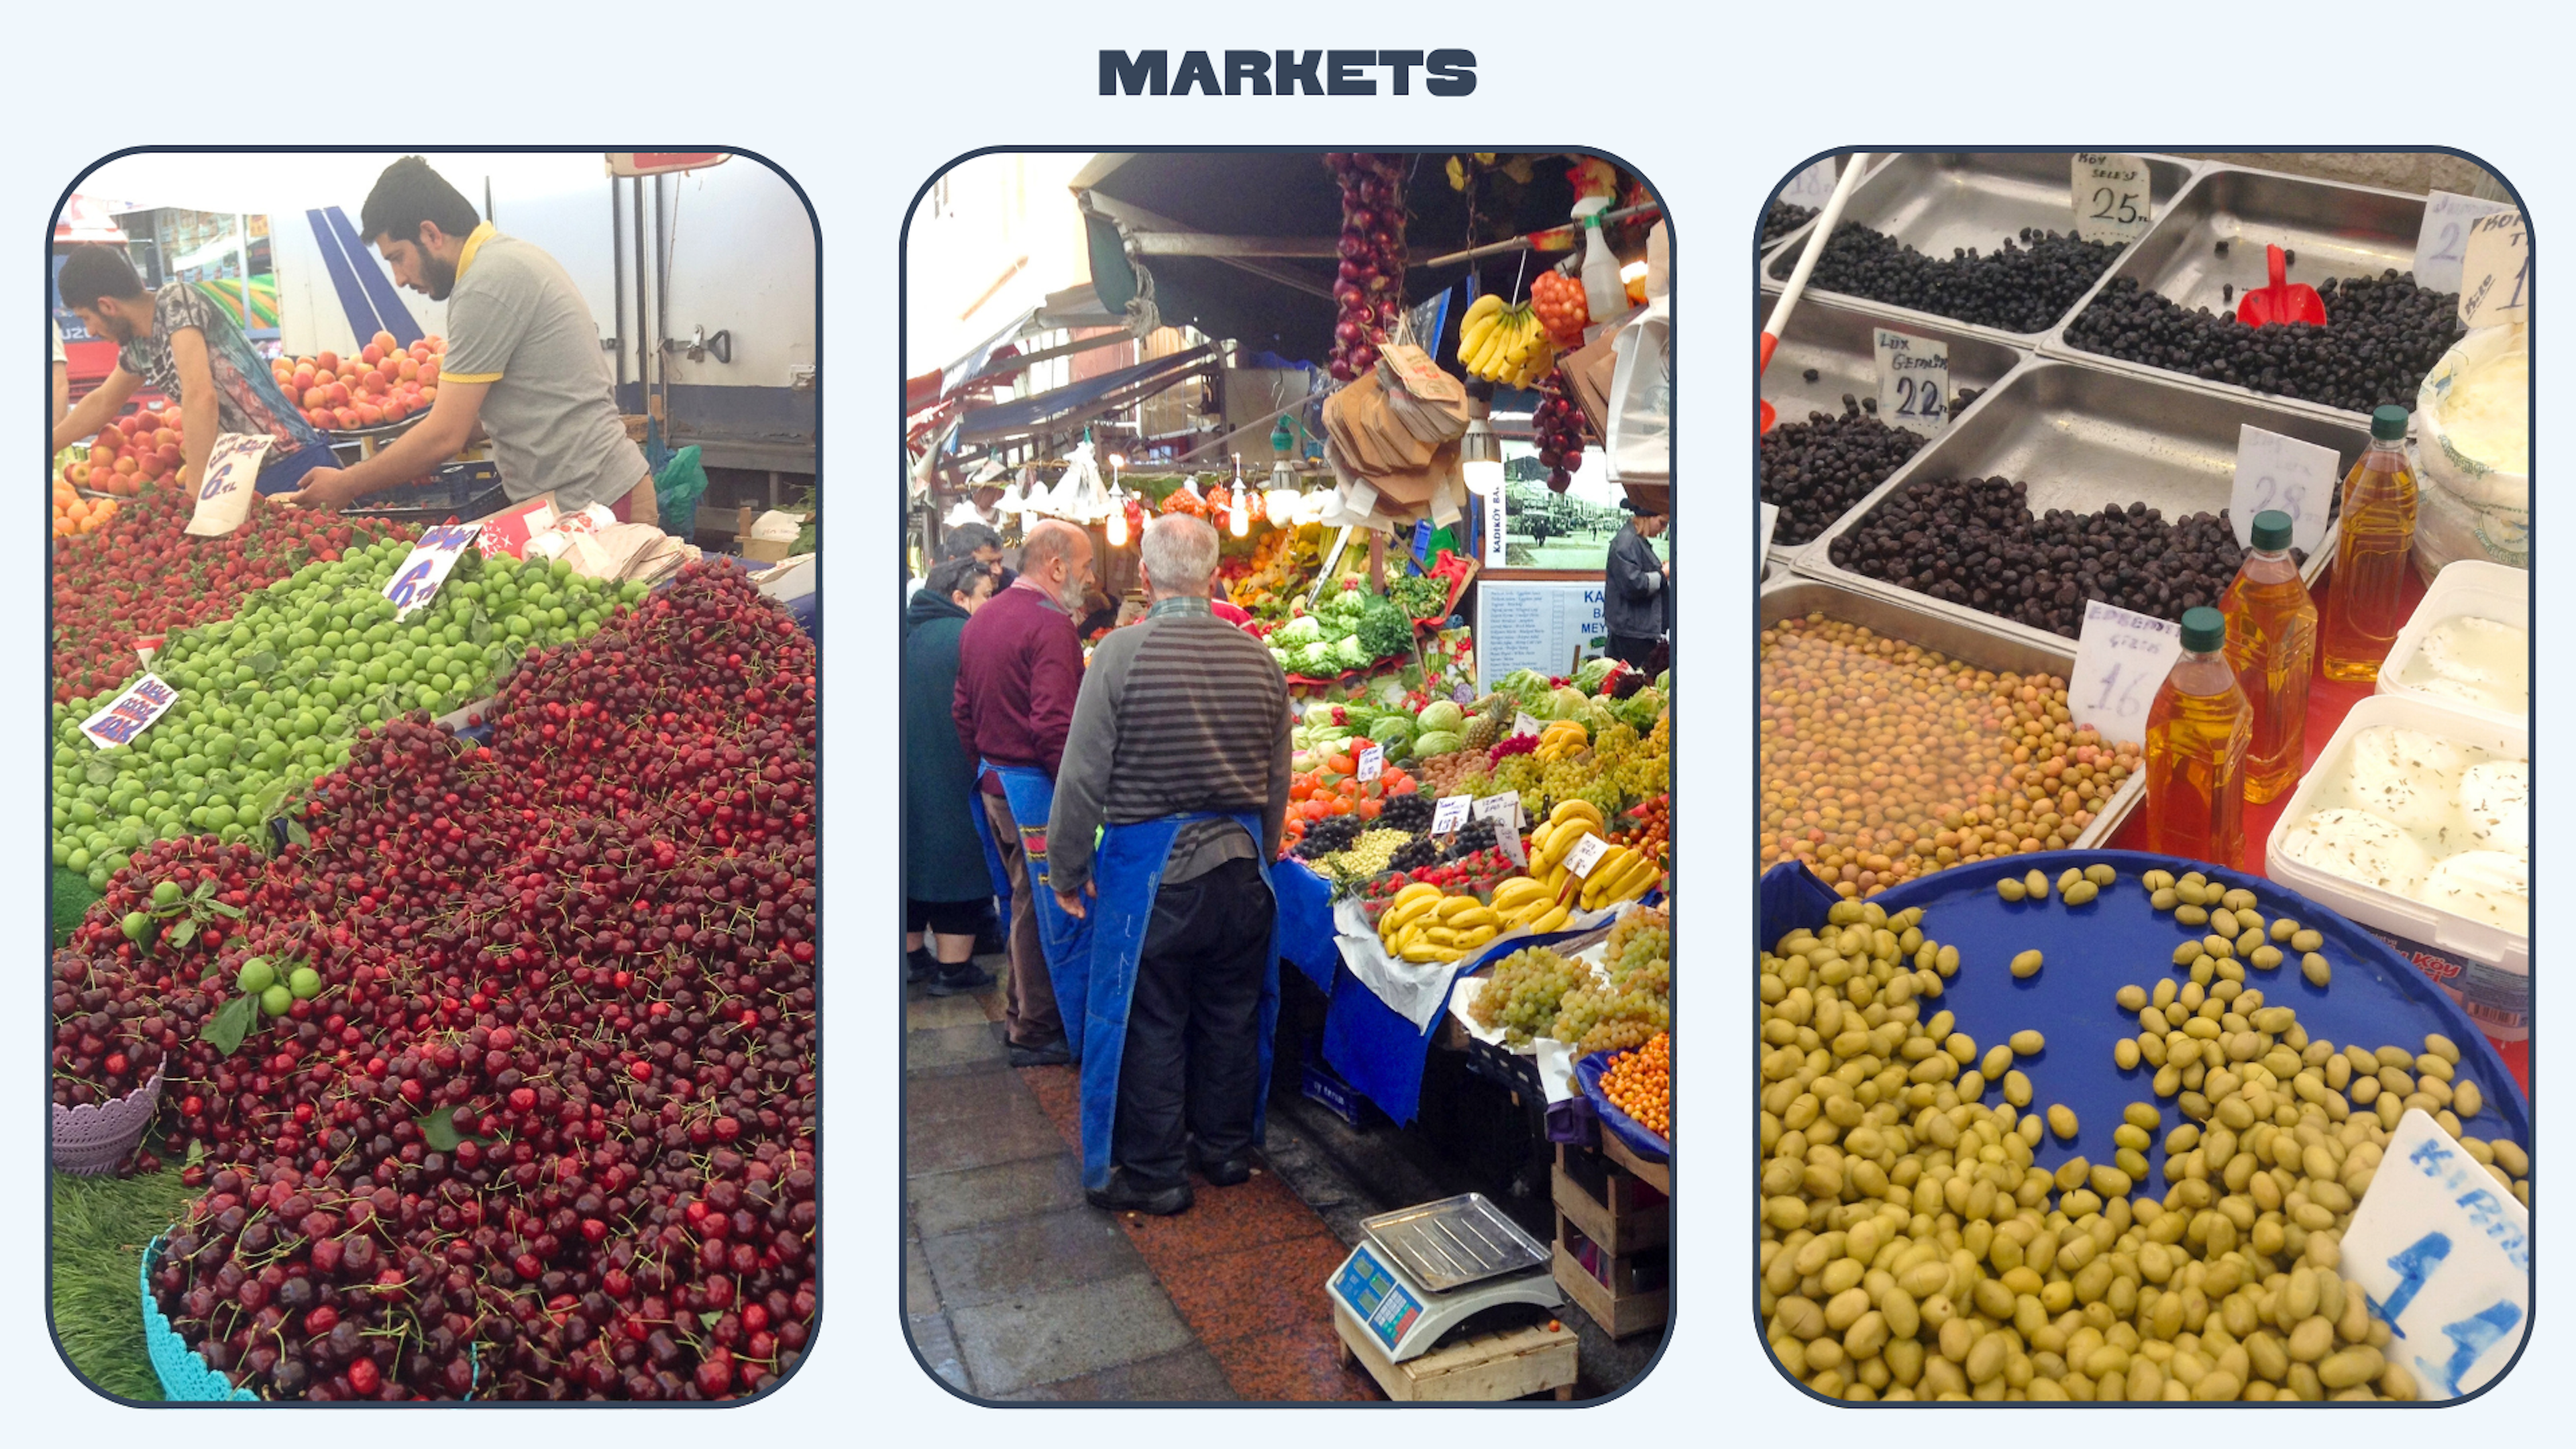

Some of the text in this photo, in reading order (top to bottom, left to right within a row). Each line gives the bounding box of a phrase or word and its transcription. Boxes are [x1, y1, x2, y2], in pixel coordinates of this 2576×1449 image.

[2090, 188, 2139, 223] 25
[1896, 376, 1940, 416] 22
[1492, 508, 1501, 553] KADIKÖY
[2088, 663, 2149, 717] 16
